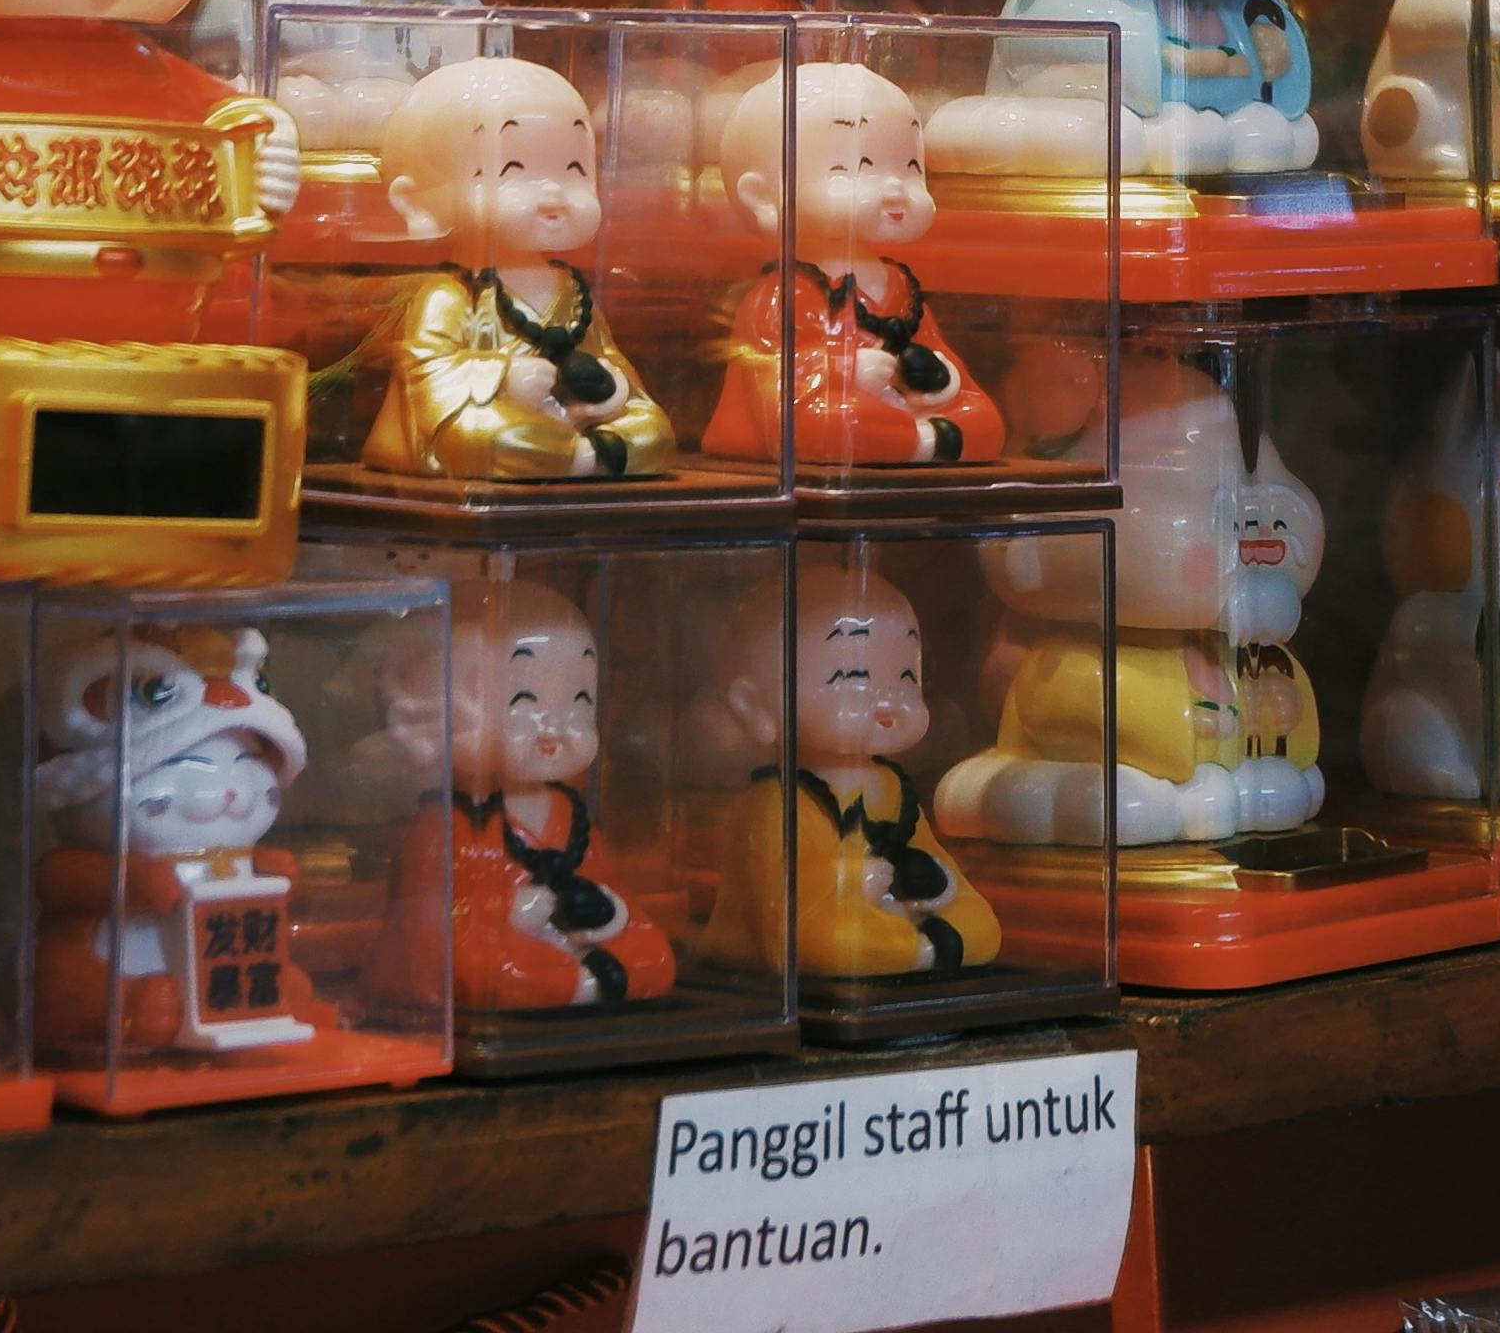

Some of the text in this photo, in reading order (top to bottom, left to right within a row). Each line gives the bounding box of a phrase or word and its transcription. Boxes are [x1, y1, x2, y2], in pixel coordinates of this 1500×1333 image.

[667, 1073, 1118, 1182] Panggil staff untuk
[654, 1214, 884, 1279] bantuan.
